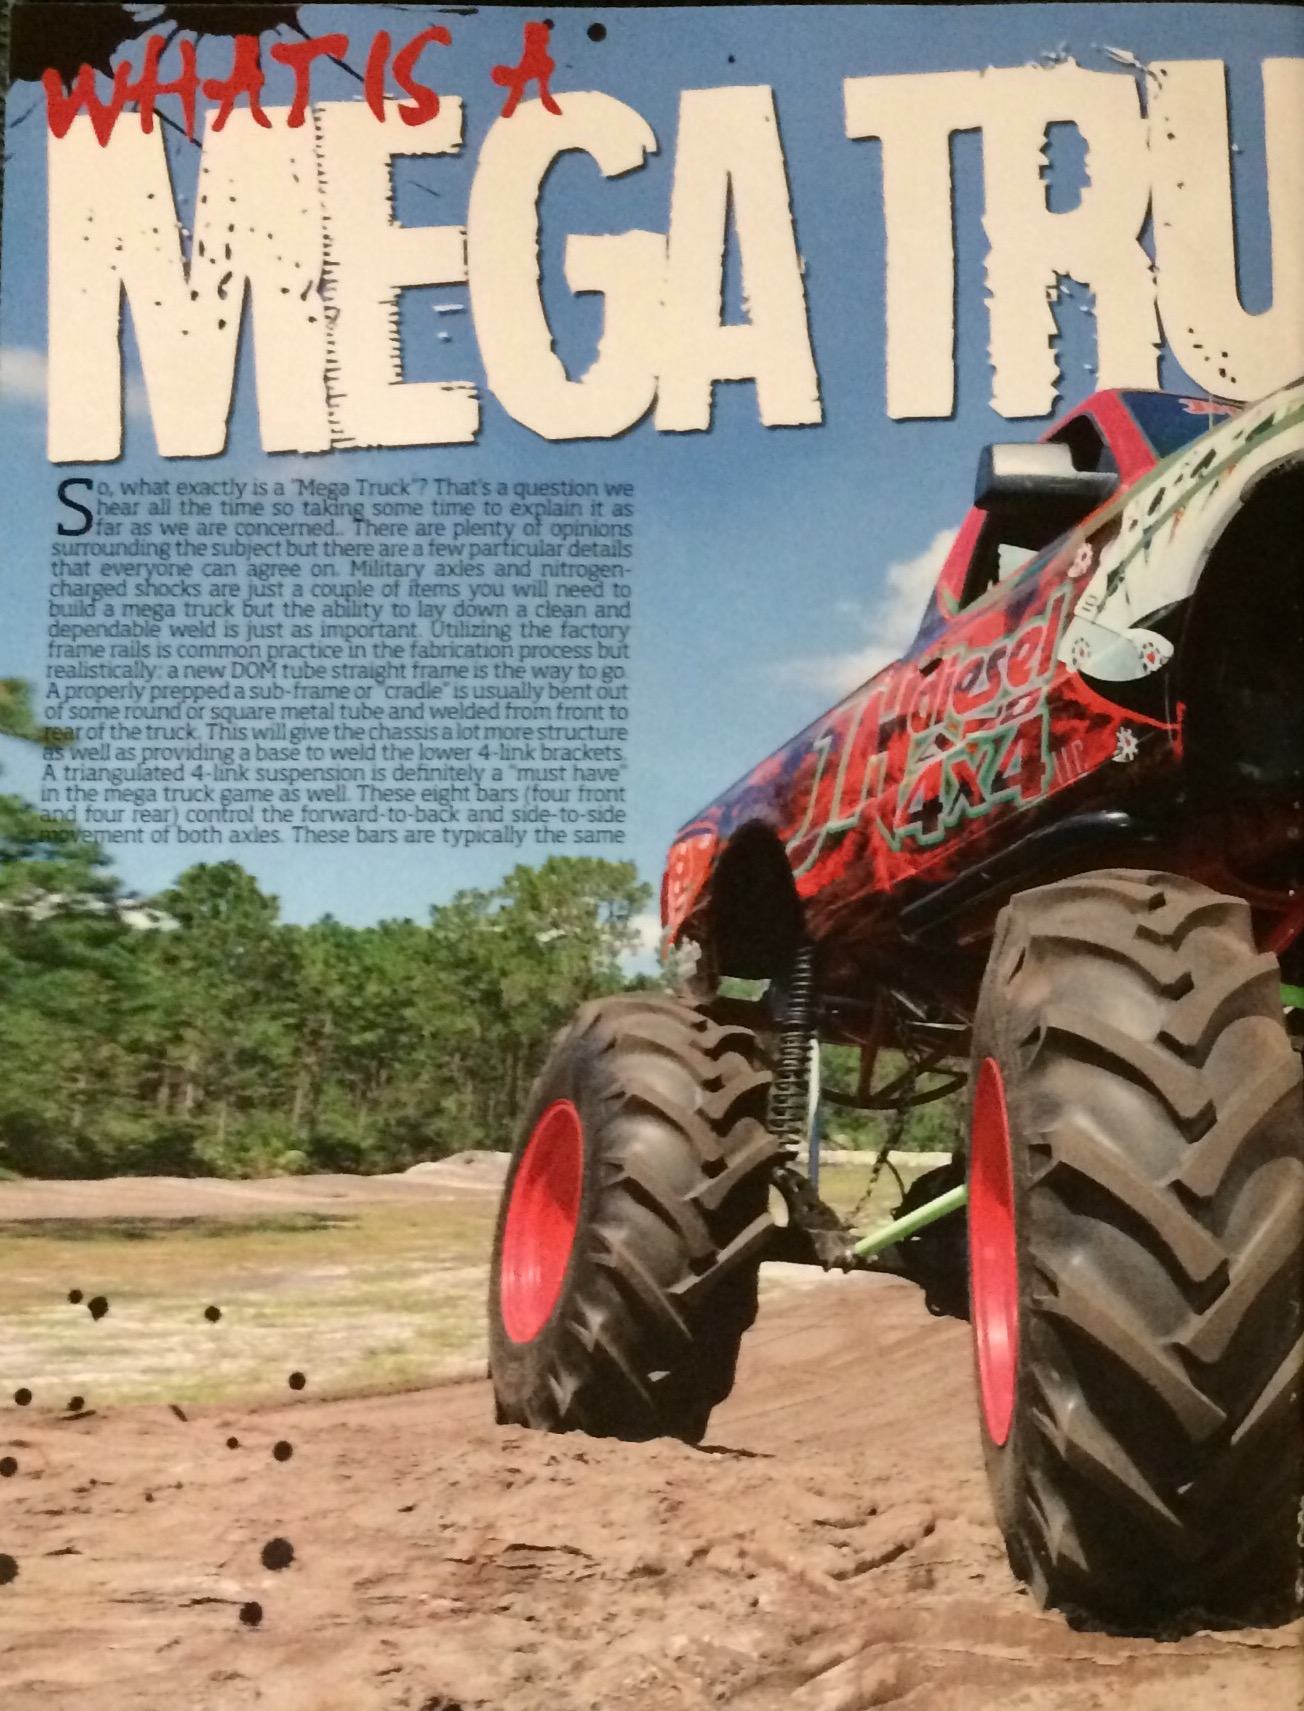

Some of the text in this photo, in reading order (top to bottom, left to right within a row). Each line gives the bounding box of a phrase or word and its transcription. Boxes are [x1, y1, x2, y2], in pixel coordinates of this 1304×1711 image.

[42, 21, 563, 146] WHAT IS A
[46, 84, 823, 465] MEGA
[57, 478, 113, 536] So,
[120, 479, 170, 496] what
[176, 479, 246, 500] exactly
[252, 479, 268, 496] is
[273, 483, 285, 496] a
[437, 479, 491, 496] That's
[496, 483, 508, 496] a
[513, 479, 598, 500] question
[604, 483, 634, 496] we
[50, 560, 632, 581] that everyone can agree on. Military axles and nitrogen-
[44, 702, 630, 724] of some round or square metal tube and welded from front to
[40, 785, 626, 806] in the mega truck game as well. These eight bars (four front
